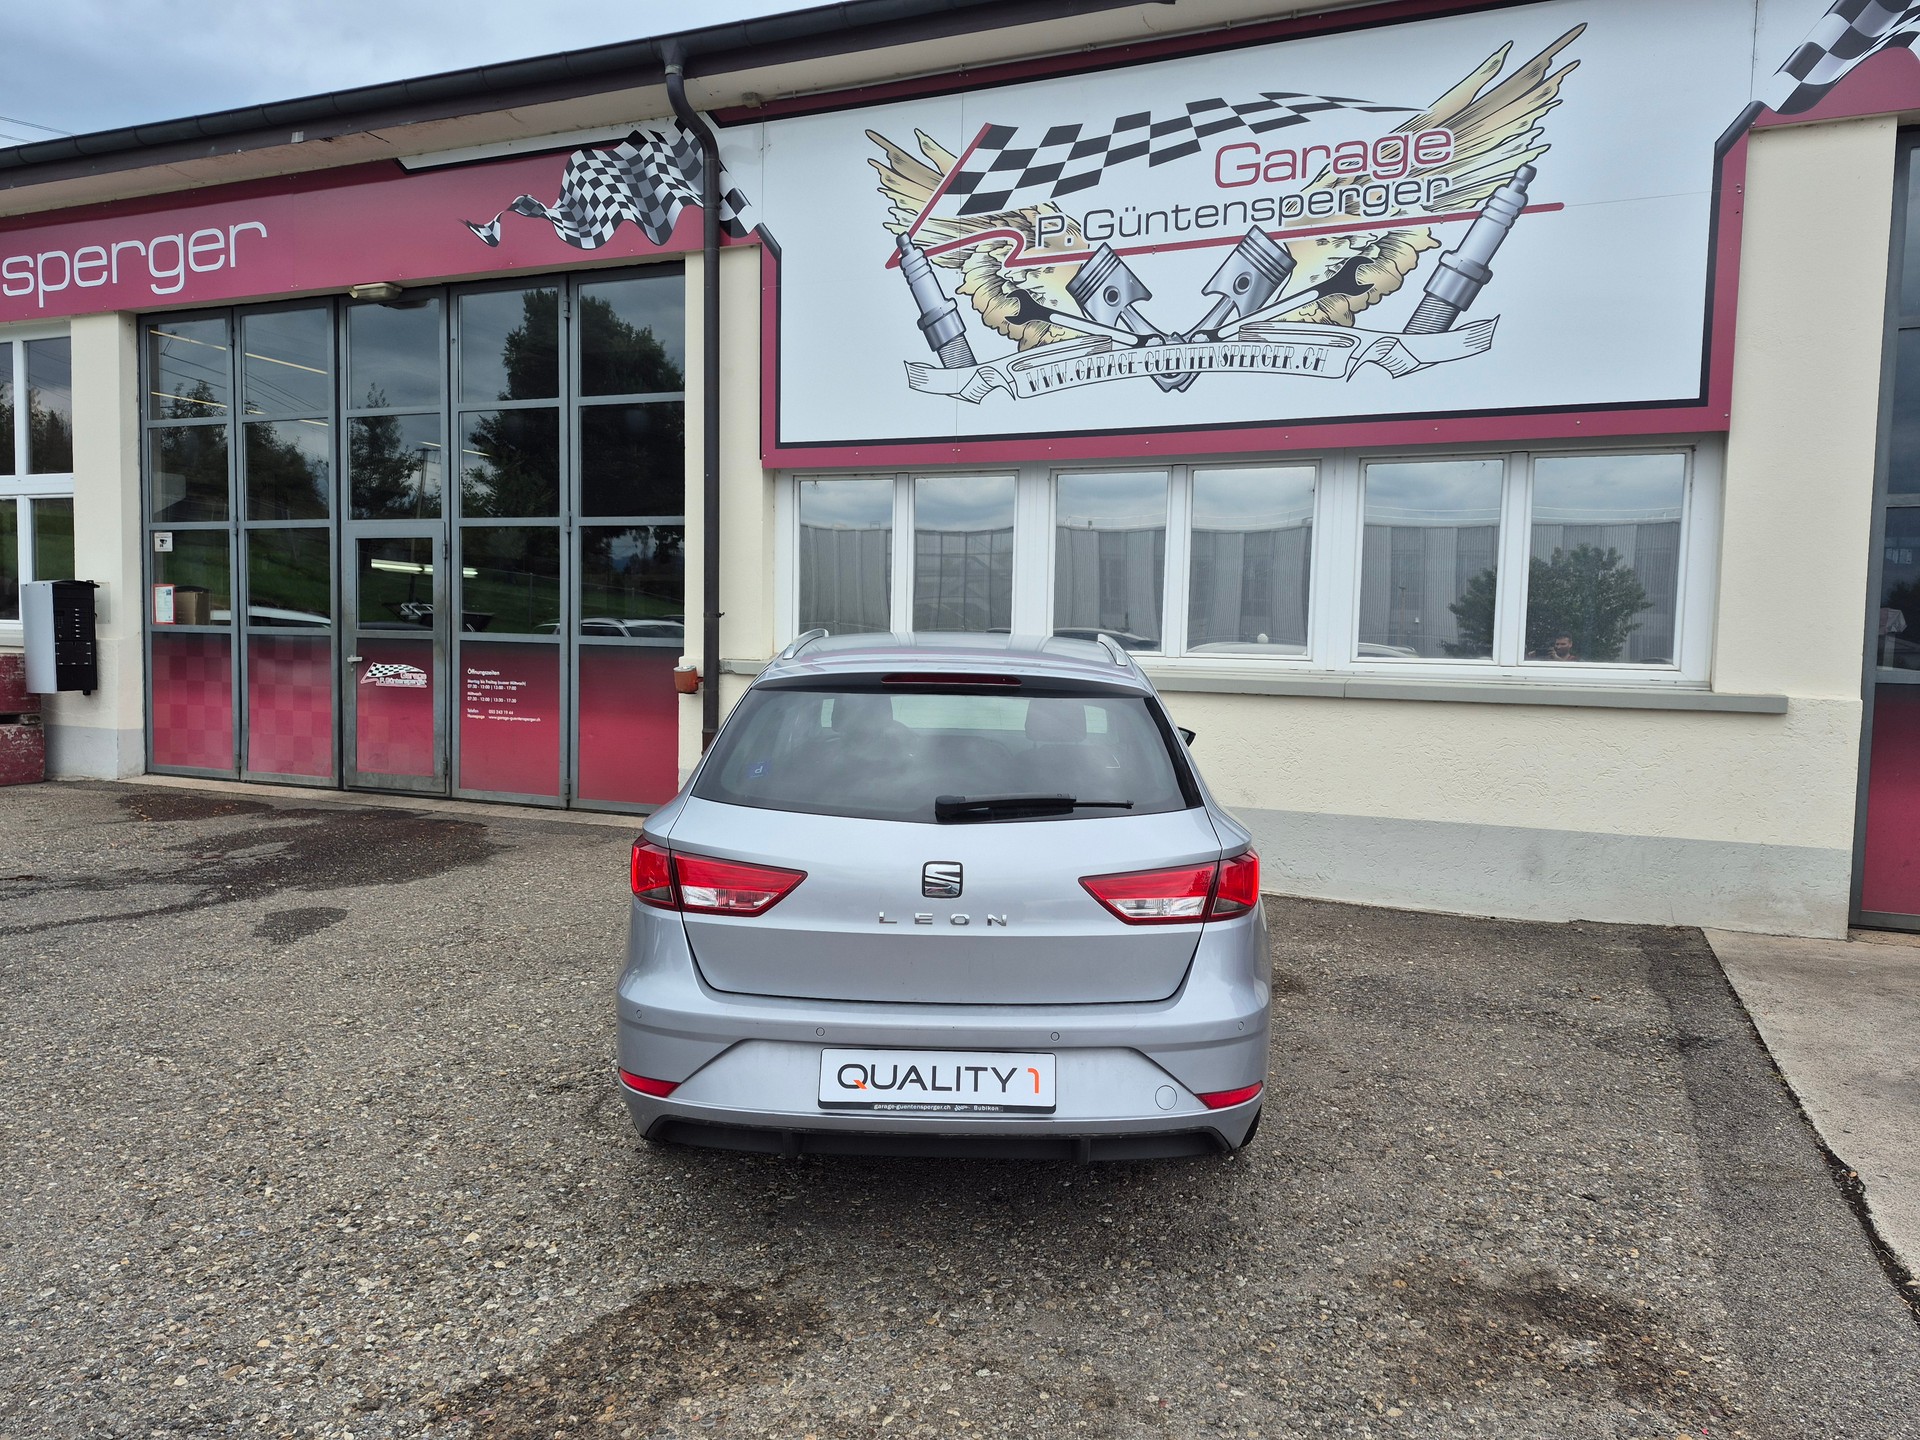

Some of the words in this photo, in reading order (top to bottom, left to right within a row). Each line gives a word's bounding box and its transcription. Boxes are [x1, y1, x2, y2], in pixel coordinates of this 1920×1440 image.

[1215, 128, 1453, 190] Garage
[1035, 214, 1074, 248] P.
[1083, 175, 1450, 243] Güntensperger
[2, 221, 268, 309] sperger
[878, 911, 1008, 927] LEON
